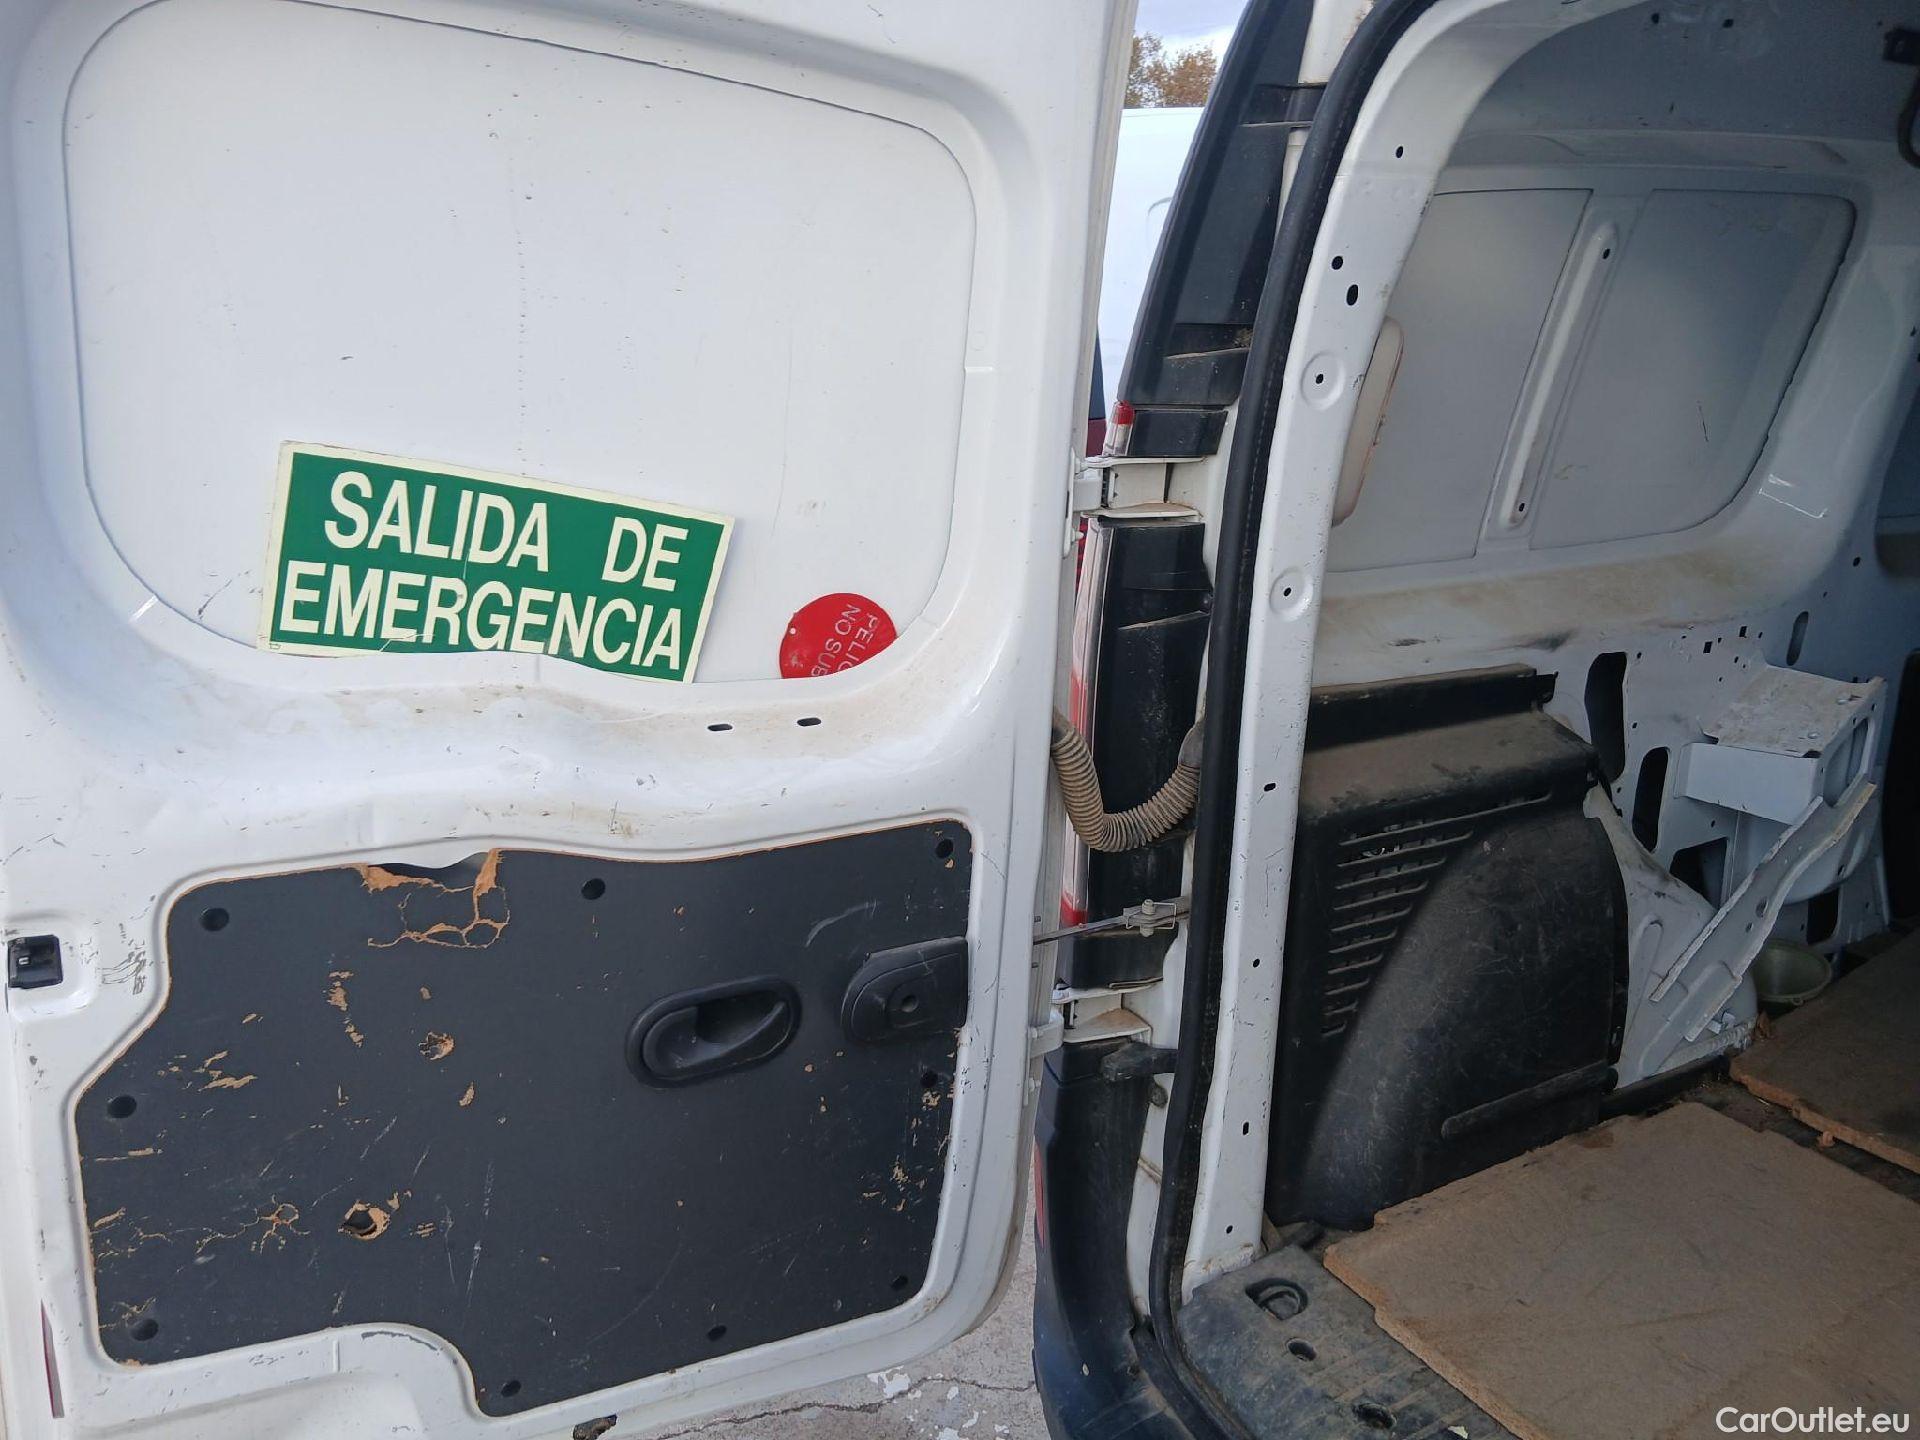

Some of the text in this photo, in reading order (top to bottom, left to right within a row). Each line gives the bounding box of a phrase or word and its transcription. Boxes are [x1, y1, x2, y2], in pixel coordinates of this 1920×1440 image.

[324, 471, 689, 592] SALIDA DE
[278, 559, 682, 670] EMERGENCIA
[811, 603, 861, 677] NO SUB
